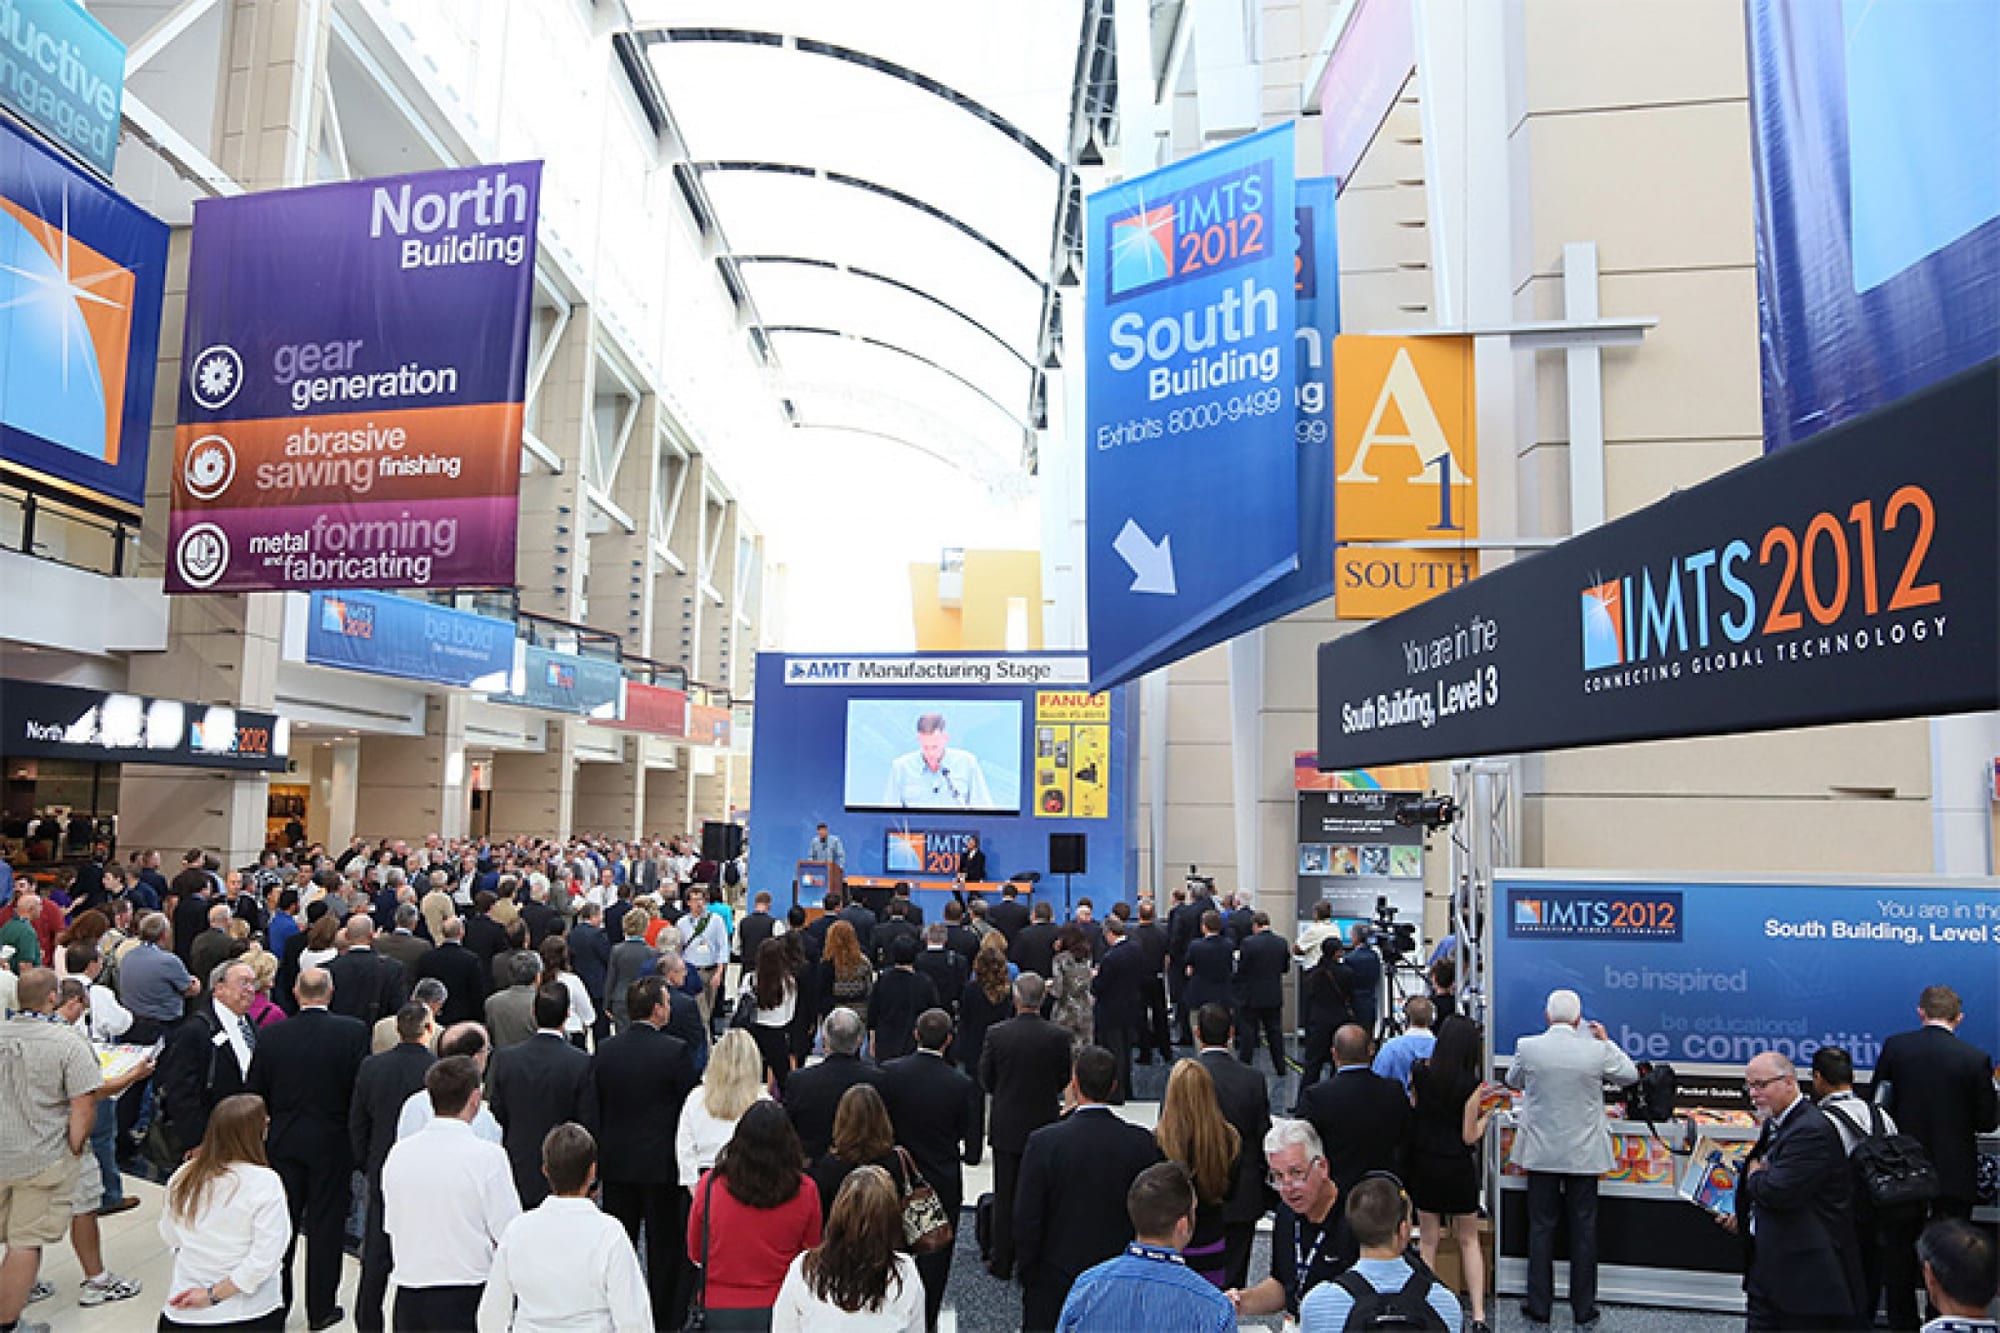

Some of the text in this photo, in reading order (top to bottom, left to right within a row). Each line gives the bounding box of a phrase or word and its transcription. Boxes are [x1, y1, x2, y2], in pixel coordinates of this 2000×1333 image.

[370, 172, 527, 239] North
[1178, 175, 1262, 233] IMTS
[401, 231, 526, 269] Building
[1180, 213, 1264, 274] 2012
[1109, 278, 1279, 371] South
[274, 338, 364, 384] gear
[1149, 346, 1280, 401] Building
[291, 363, 457, 411] generation
[1096, 418, 1163, 451] Exhibits
[1167, 387, 1282, 434] 8000-9499
[1337, 347, 1472, 484] A
[285, 422, 407, 456] abrasive
[256, 453, 462, 493] sawing finishing
[1424, 452, 1464, 531] 1
[250, 511, 458, 556] metal forming
[263, 551, 432, 584] and fabricating
[1344, 560, 1470, 590] SOUTH
[1402, 640, 1429, 676] You
[1454, 624, 1468, 661] in
[1470, 614, 1498, 654] the
[1584, 616, 1946, 694] CONNECTING GLOBAL TECHNOLOGY
[807, 661, 1051, 683] AMT Manufacturing Stage
[1039, 694, 1106, 709] FANUC
[1341, 664, 1499, 734] South Building, Level 3
[926, 851, 961, 873] 201
[1877, 899, 1912, 918] You
[1918, 902, 1947, 918] are
[1954, 901, 1971, 919] in
[1764, 920, 1826, 938] South
[1831, 920, 1923, 945] Building,
[1929, 923, 1988, 942] Level
[1604, 965, 1747, 994] be inspired
[1620, 1025, 1670, 1058] be
[1694, 1014, 1808, 1034] educational
